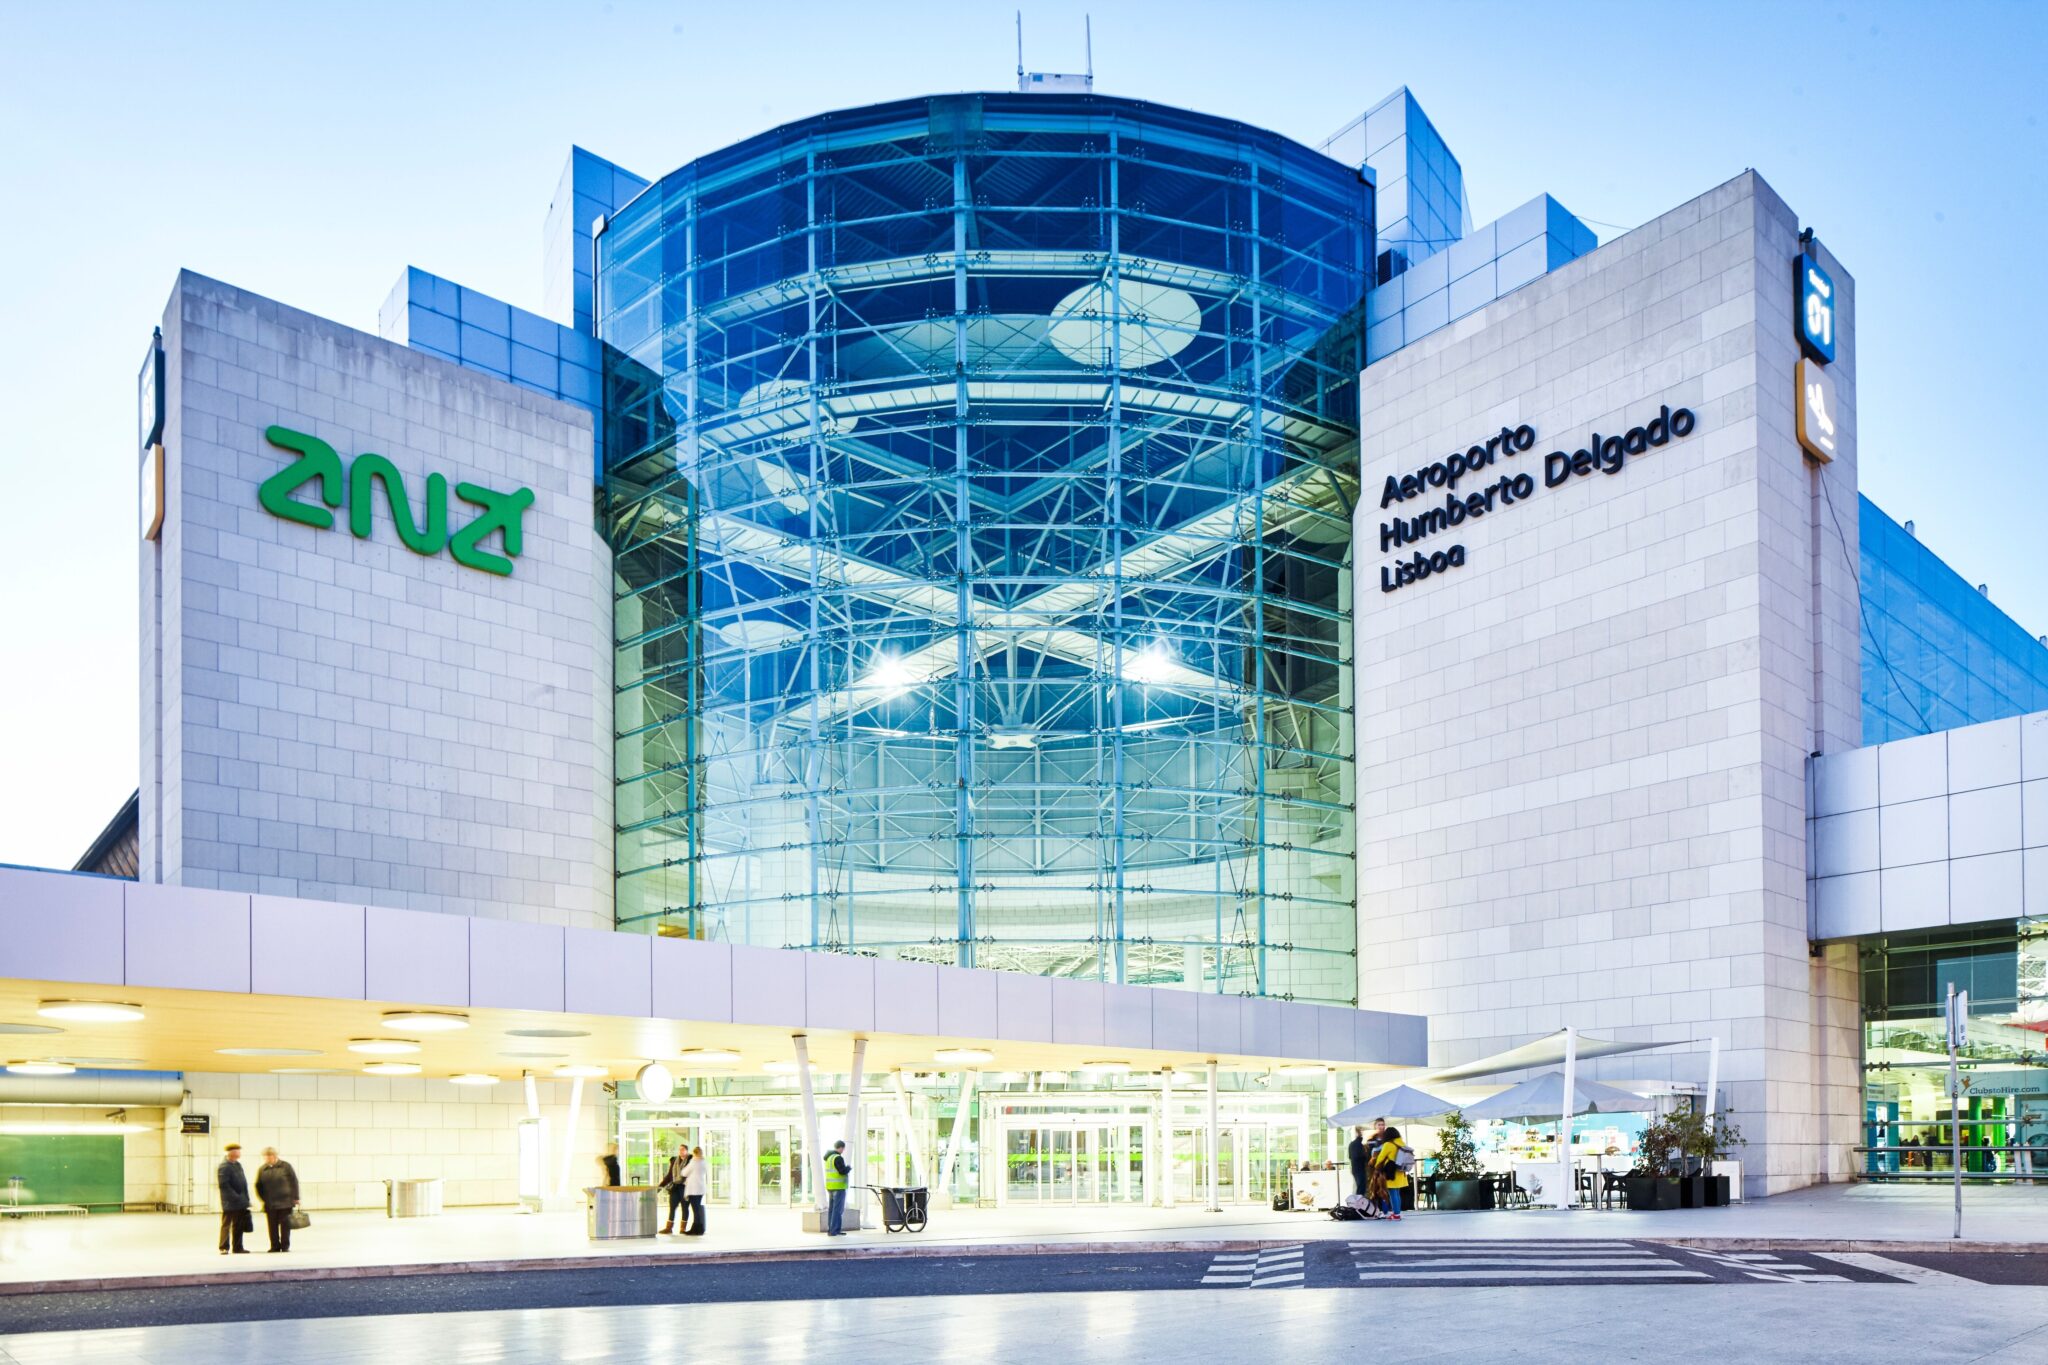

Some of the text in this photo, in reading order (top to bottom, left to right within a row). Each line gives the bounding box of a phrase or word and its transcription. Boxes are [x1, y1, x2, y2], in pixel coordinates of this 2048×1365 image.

[1380, 424, 1536, 509] Aeroporto
[1380, 404, 1696, 553] Humberto Delgado
[1380, 544, 1465, 593] Lisboa
[1969, 1086, 2040, 1095] ClubstoHire.com
